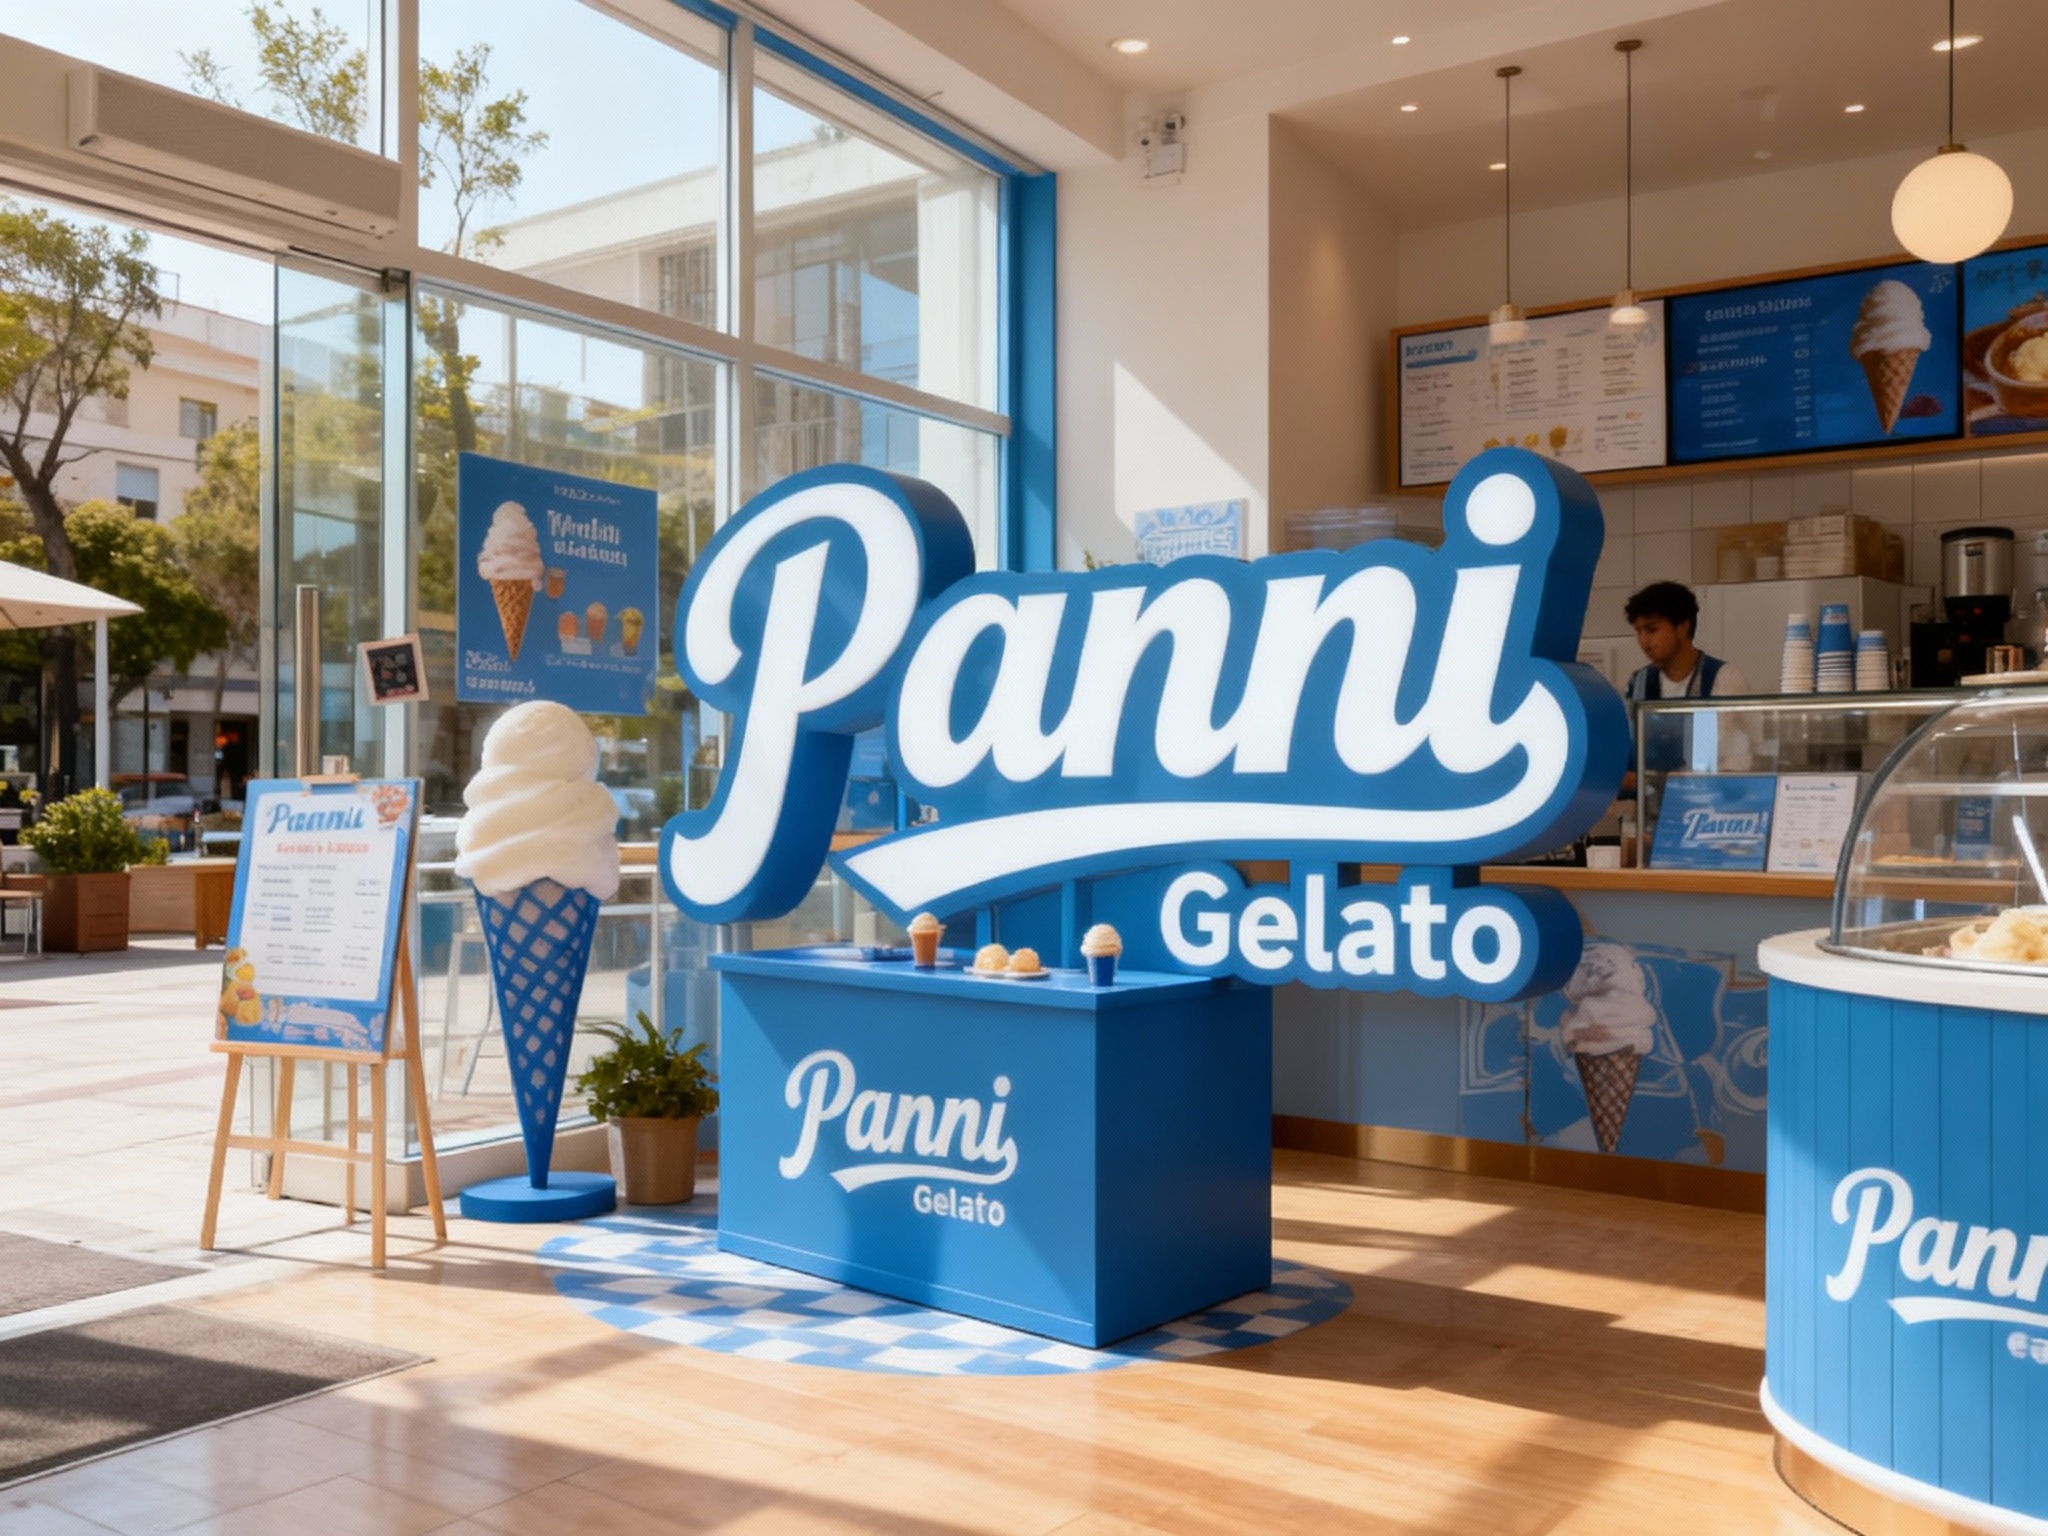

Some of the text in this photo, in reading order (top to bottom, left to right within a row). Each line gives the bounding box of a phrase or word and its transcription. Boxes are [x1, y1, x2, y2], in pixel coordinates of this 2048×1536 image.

[671, 473, 1568, 909] Panni
[1161, 872, 1522, 984] Gelato
[779, 1050, 1018, 1191] Panni
[913, 1184, 1006, 1228] Gelato
